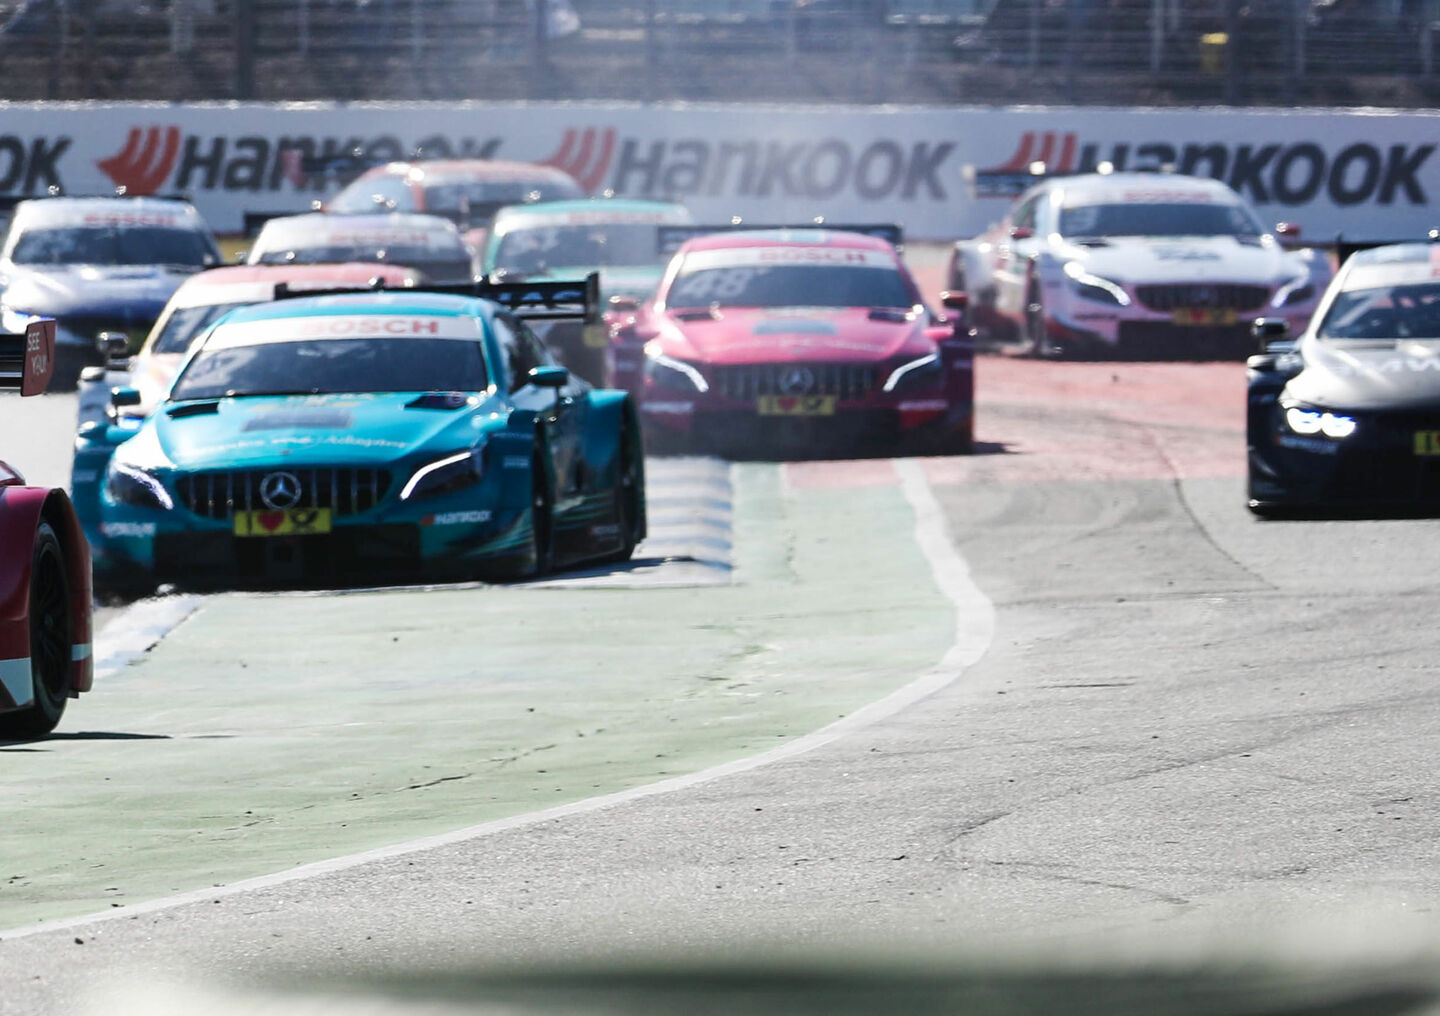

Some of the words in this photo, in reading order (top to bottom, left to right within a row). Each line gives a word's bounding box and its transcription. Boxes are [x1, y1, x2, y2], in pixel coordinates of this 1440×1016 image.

[758, 249, 867, 265] BOSCH
[680, 272, 756, 297] 48
[302, 318, 439, 334] BOSCH
